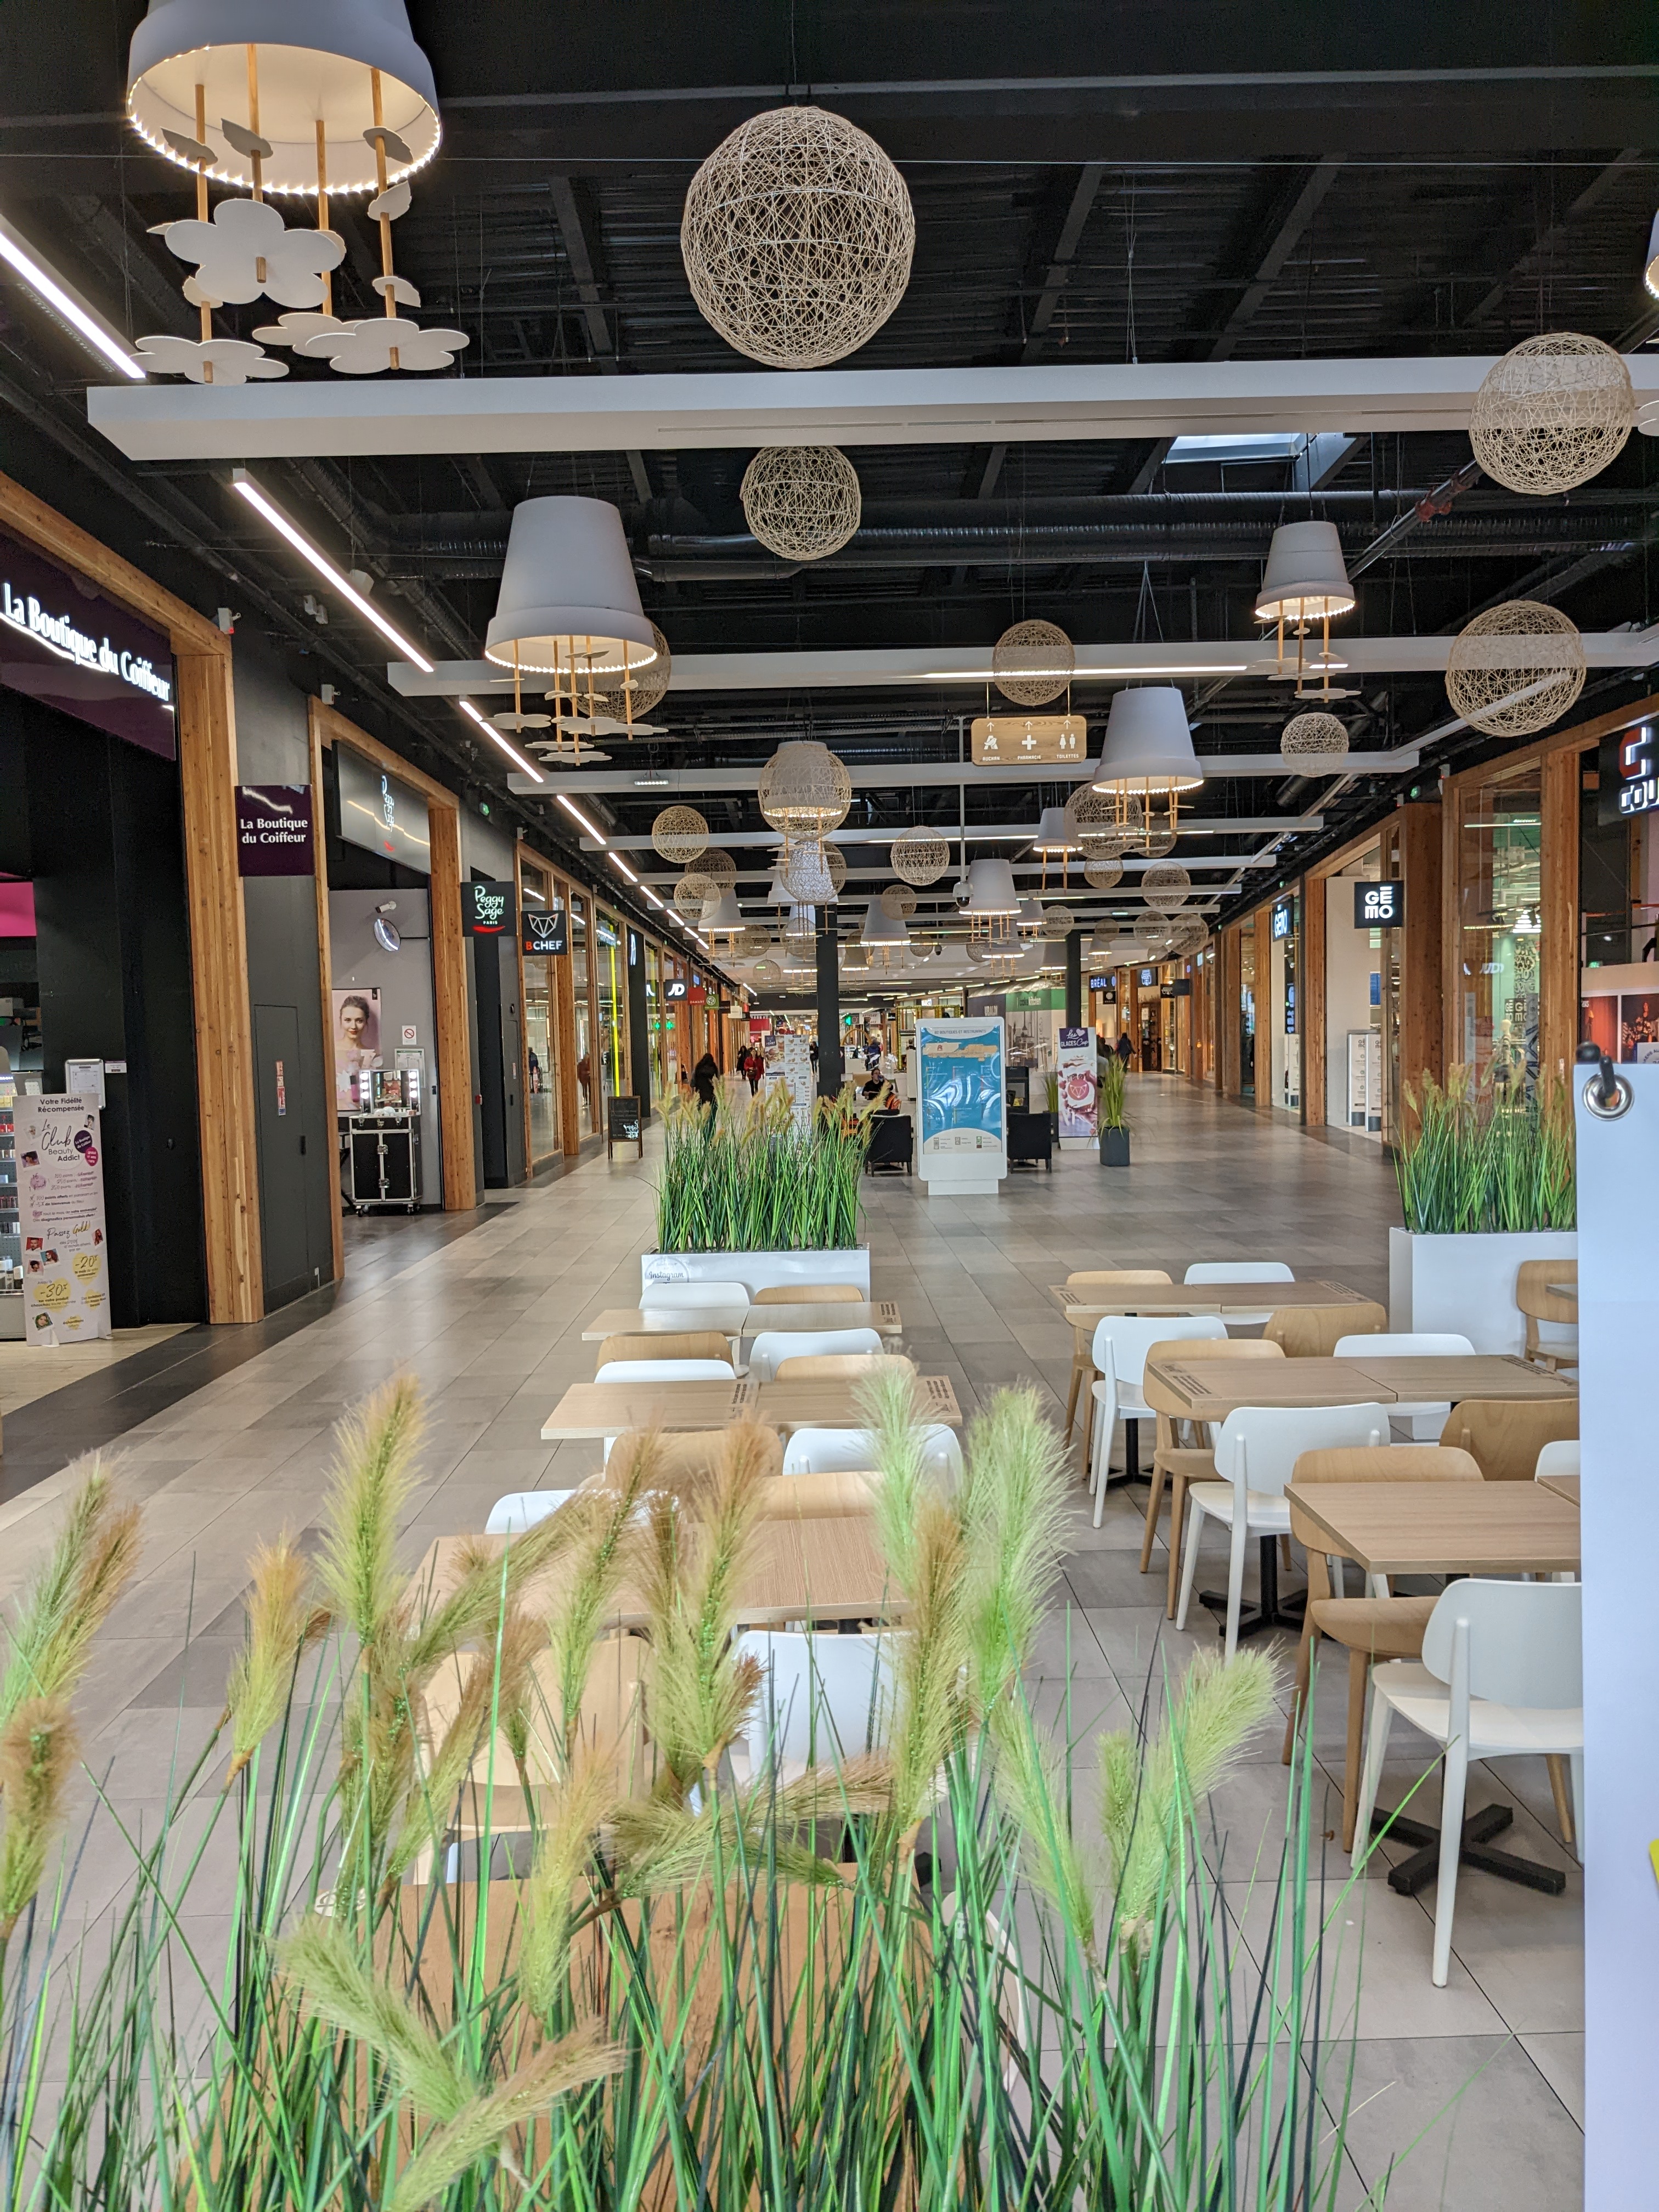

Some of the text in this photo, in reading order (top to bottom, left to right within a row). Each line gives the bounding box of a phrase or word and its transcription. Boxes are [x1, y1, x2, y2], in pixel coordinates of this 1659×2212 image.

[3, 583, 171, 701] La Boutique du Coiffeur
[240, 817, 308, 831] La Boutique
[242, 832, 306, 844] du Coiffeur
[474, 885, 504, 909] Peggy
[474, 903, 504, 920] Sage
[526, 940, 563, 950] BCHEF
[668, 984, 685, 996] JD
[1066, 1029, 1079, 1040] Les
[38, 1104, 84, 1113] Récompensée
[42, 1119, 50, 1132] Le
[41, 1125, 72, 1150] Club
[47, 1227, 70, 1240] Passez
[649, 1271, 684, 1281] Instagram
